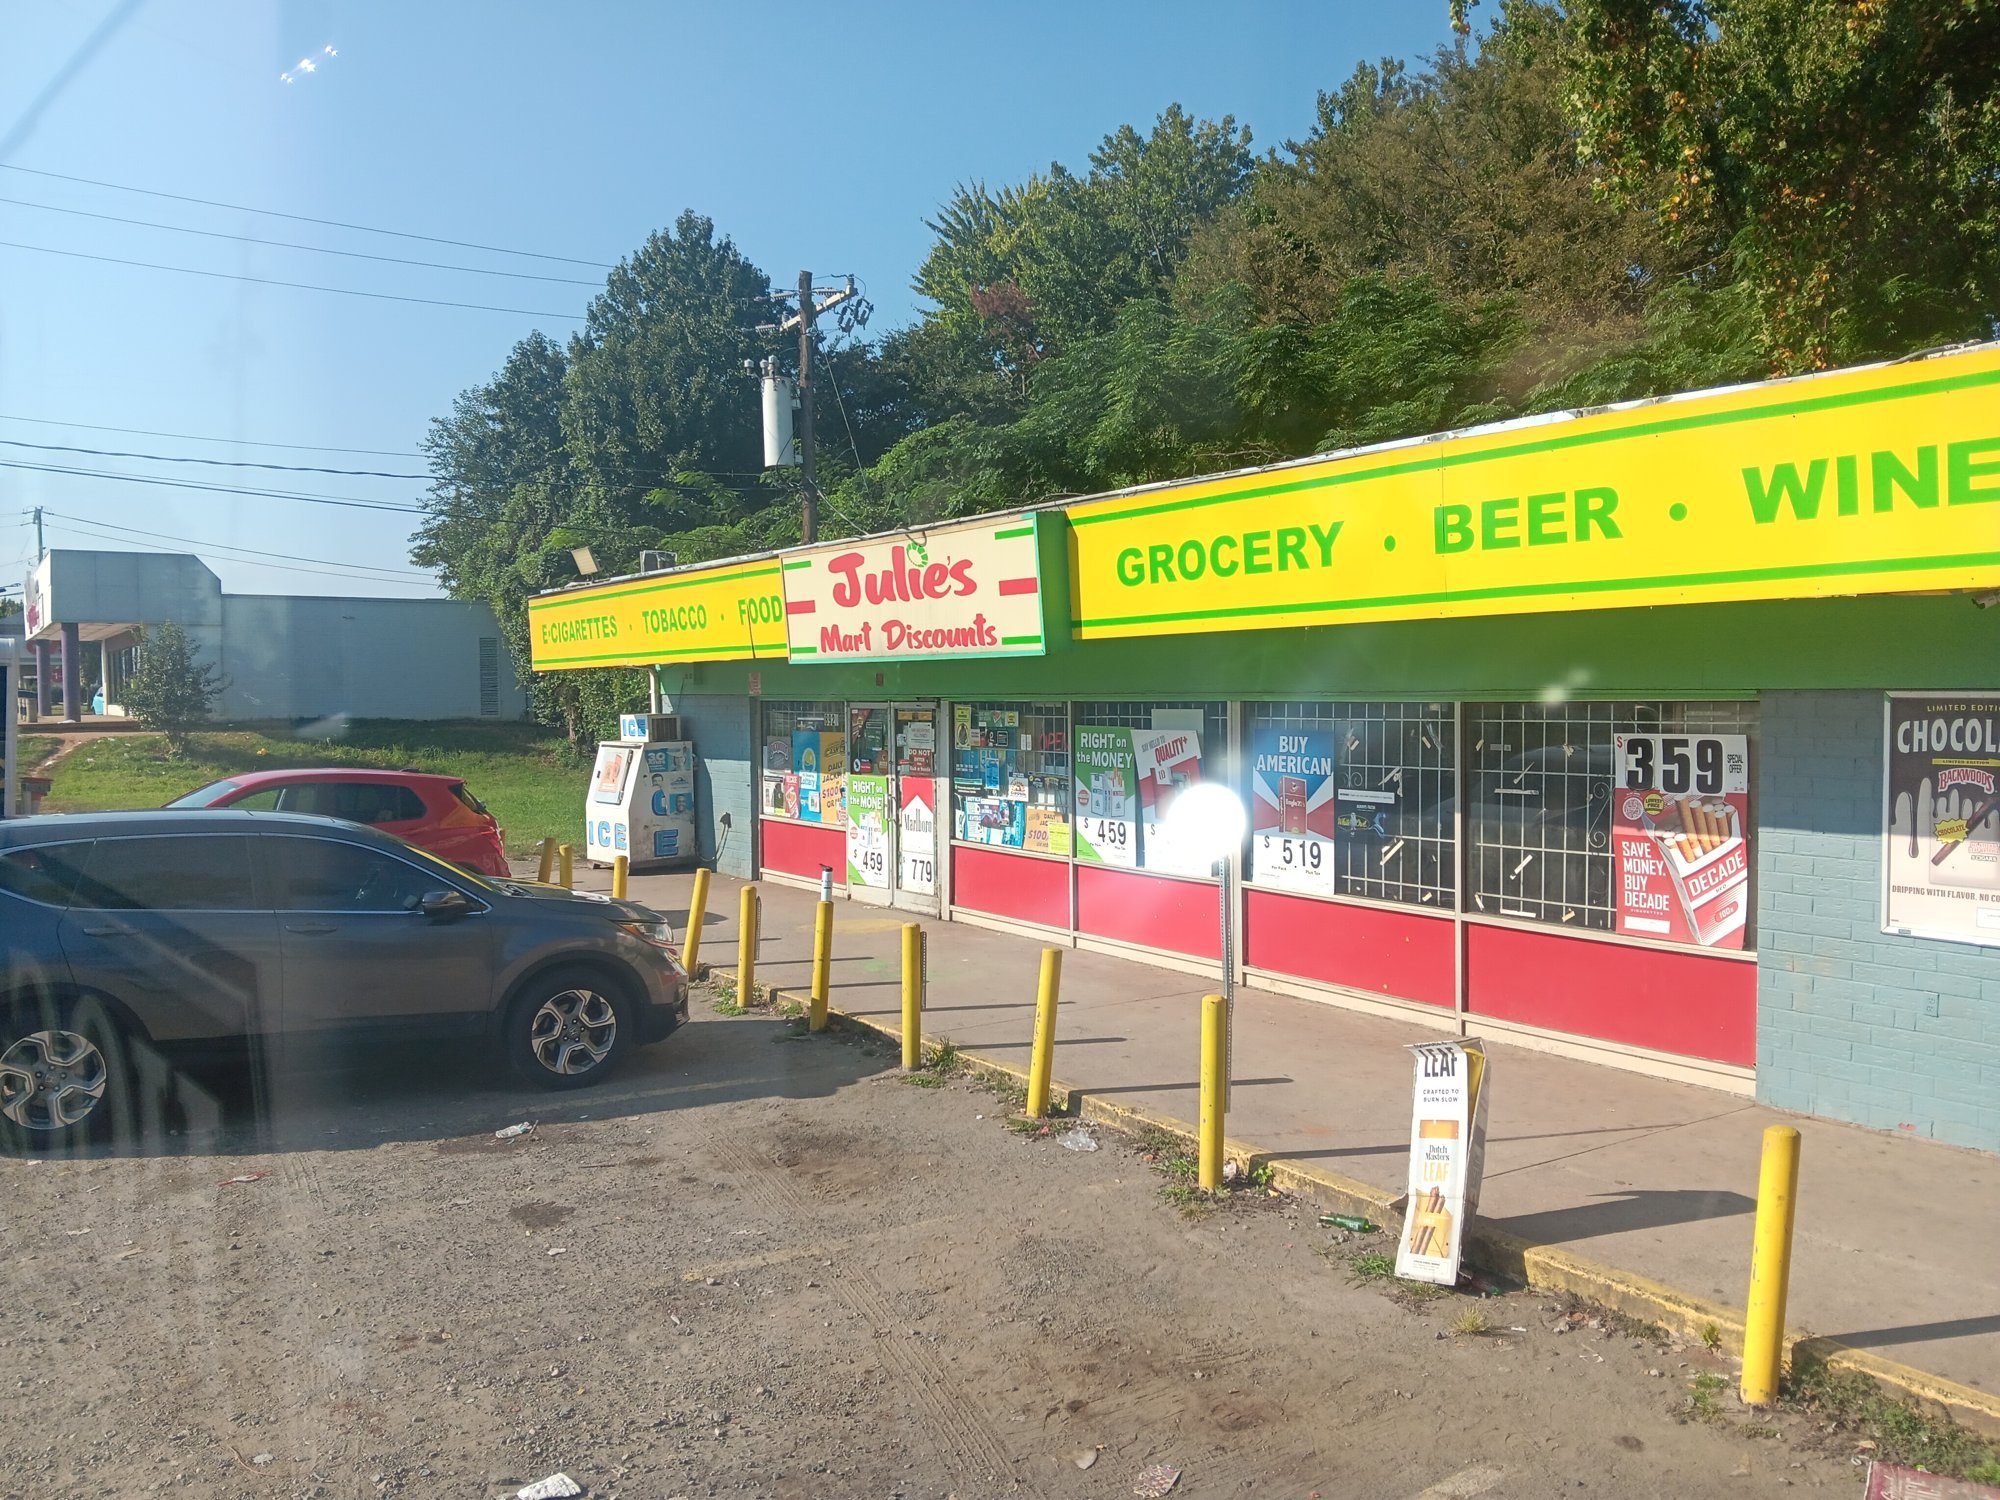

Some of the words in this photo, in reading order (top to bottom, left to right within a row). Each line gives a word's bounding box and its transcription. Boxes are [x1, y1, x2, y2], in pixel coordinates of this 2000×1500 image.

[1741, 434, 2000, 526] WINE
[1433, 486, 1624, 556] BEER
[1116, 521, 1344, 588] GROCERY
[828, 543, 978, 608] Julie's
[642, 604, 708, 635] TOBACCO
[738, 594, 783, 626] FOOD
[820, 621, 872, 653] Mart
[880, 613, 998, 651] Discounts
[1926, 704, 1967, 713] LIMITED
[1971, 703, 2000, 712] EDITI
[622, 718, 647, 737] ICE
[1897, 717, 2000, 754] CHOCOL
[1080, 732, 1115, 749] RIGHT
[1116, 737, 1126, 748] on
[1278, 735, 1309, 754] BUY
[919, 749, 931, 757] NOT
[1077, 751, 1090, 763] the
[1091, 751, 1133, 769] MONEY
[1727, 753, 1744, 763] SPECIAL
[1256, 754, 1332, 776] AMERICAN
[1616, 735, 1623, 749] $
[1626, 737, 1723, 794] 359
[1728, 764, 1743, 774] OFFER
[852, 780, 876, 794] RIGHT
[876, 785, 883, 793] on
[1939, 768, 1993, 793] BACKWOODS
[850, 795, 860, 805] the
[904, 808, 932, 833] Marlboro
[1084, 817, 1089, 829] $
[1150, 823, 1156, 836] $
[588, 820, 628, 851] ICE
[1264, 834, 1270, 848] $
[853, 848, 858, 859] $
[1622, 841, 1652, 858] SAVE
[911, 858, 932, 883] 779
[1623, 858, 1666, 876] MONEY.
[1688, 850, 1745, 897] DECADE
[1624, 874, 1648, 891] BUY
[1624, 891, 1670, 911] DECADE
[1891, 884, 1925, 896] DRIPPING
[1926, 888, 1946, 898] WITH
[1947, 890, 1978, 901] FLAVOR.
[1979, 893, 1990, 902] NO
[1417, 1046, 1458, 1077] LEAF
[1423, 1162, 1450, 1182] LEAF
